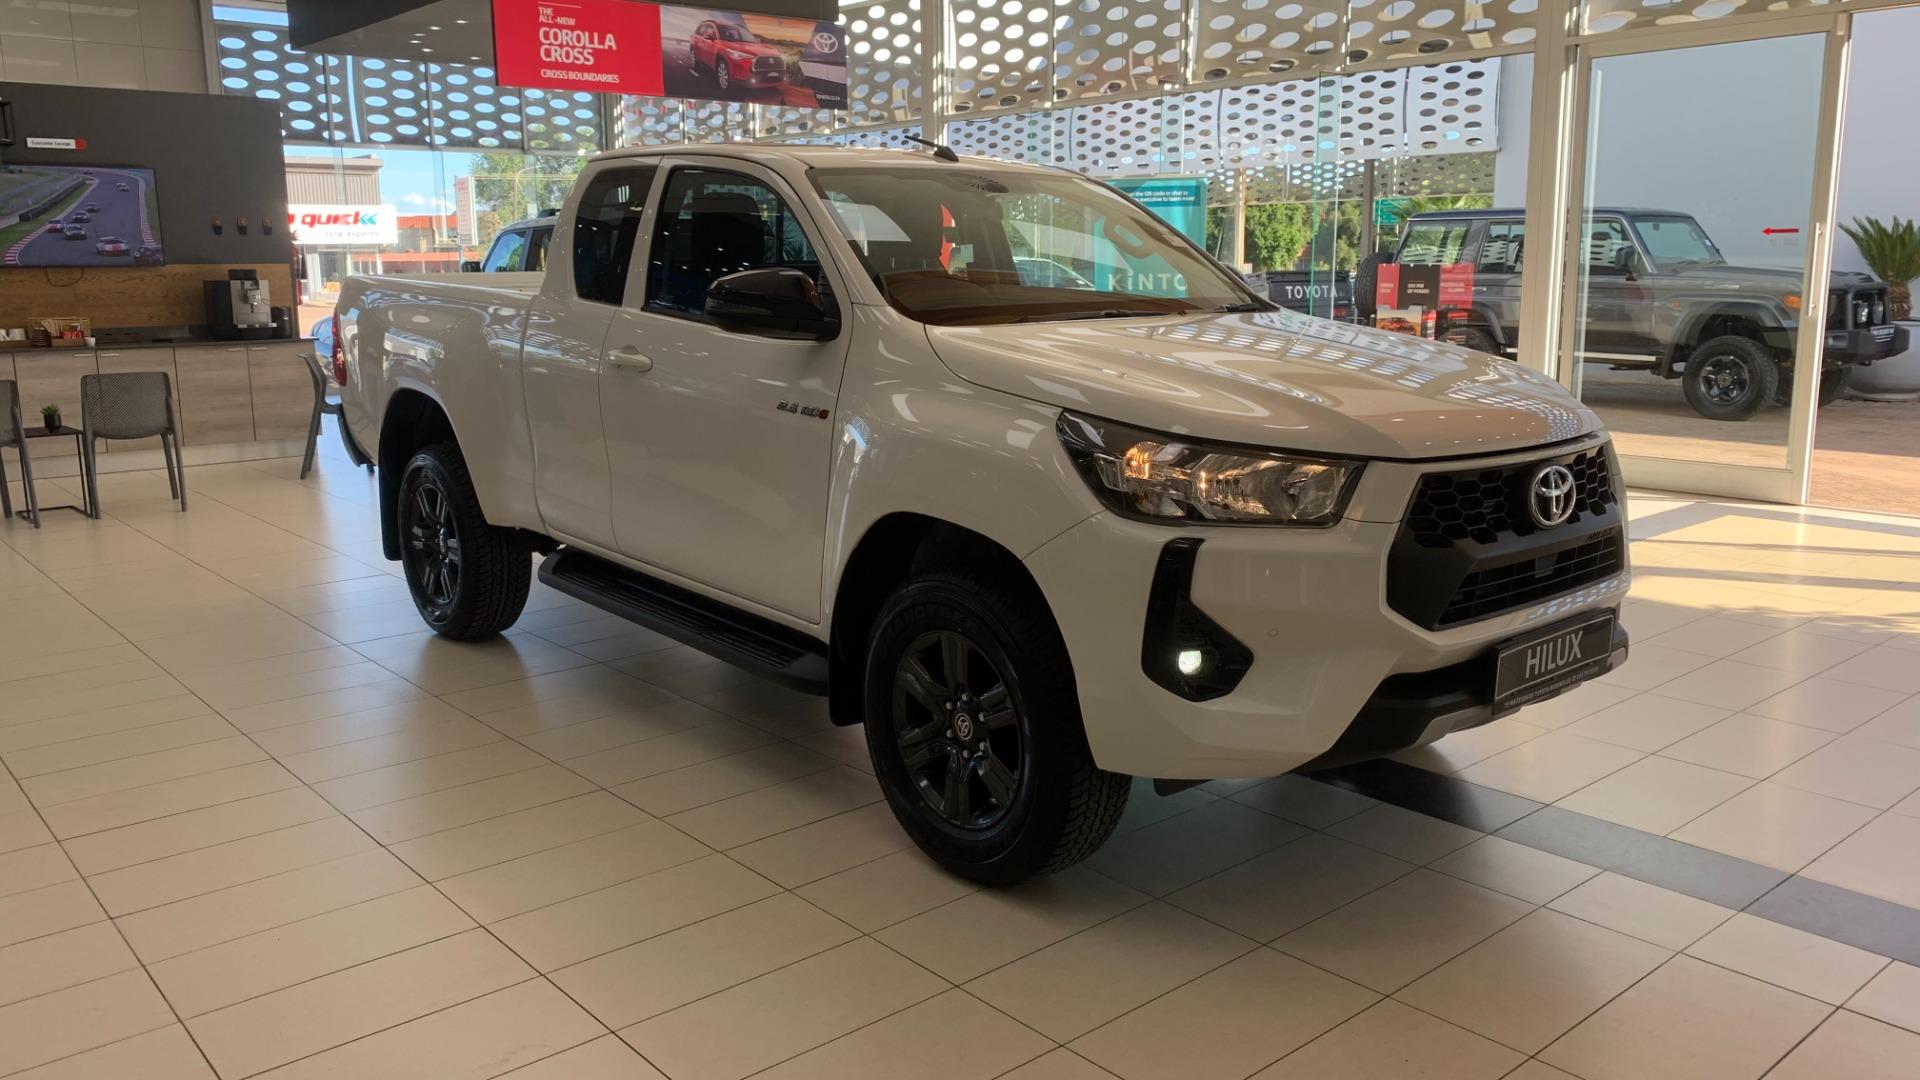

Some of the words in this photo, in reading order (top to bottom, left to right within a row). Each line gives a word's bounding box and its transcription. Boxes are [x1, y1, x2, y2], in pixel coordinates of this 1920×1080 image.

[538, 7, 554, 16] THE
[539, 14, 576, 26] ALL-NEW
[539, 27, 617, 50] COROLLA
[540, 45, 595, 65] CROSS
[541, 68, 568, 79] CROSS
[568, 71, 620, 84] BOUNDARIES
[1285, 285, 1338, 299] TOYOTA
[1525, 630, 1584, 679] HILUX
